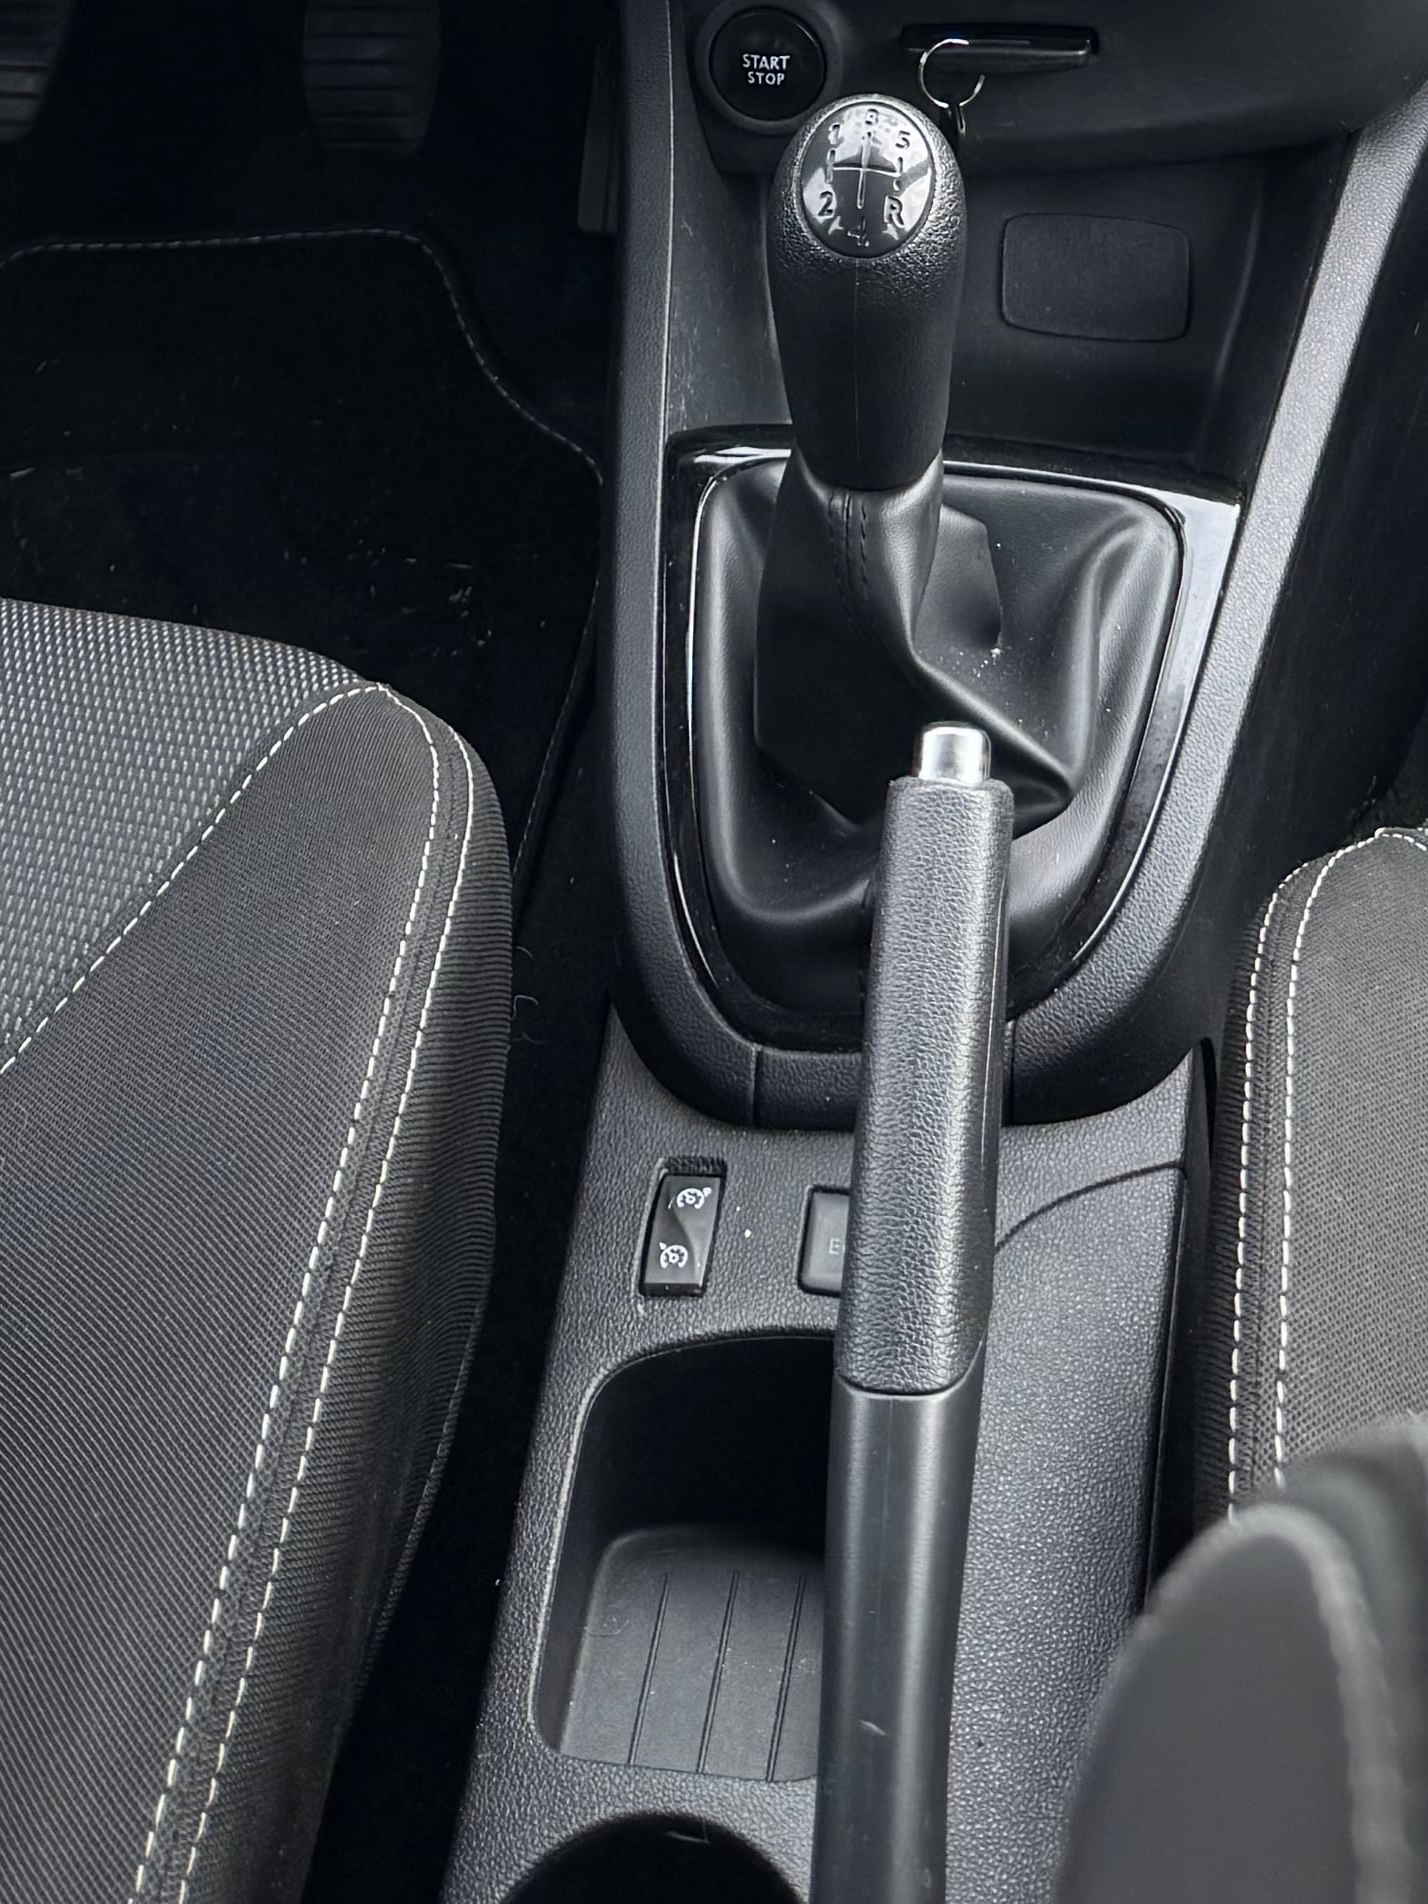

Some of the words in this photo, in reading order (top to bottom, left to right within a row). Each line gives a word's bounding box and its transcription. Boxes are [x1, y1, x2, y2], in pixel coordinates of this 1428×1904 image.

[742, 53, 790, 70] START
[747, 71, 785, 86] STOP
[895, 130, 910, 149] 5
[817, 190, 835, 218] 2
[884, 195, 905, 228] R
